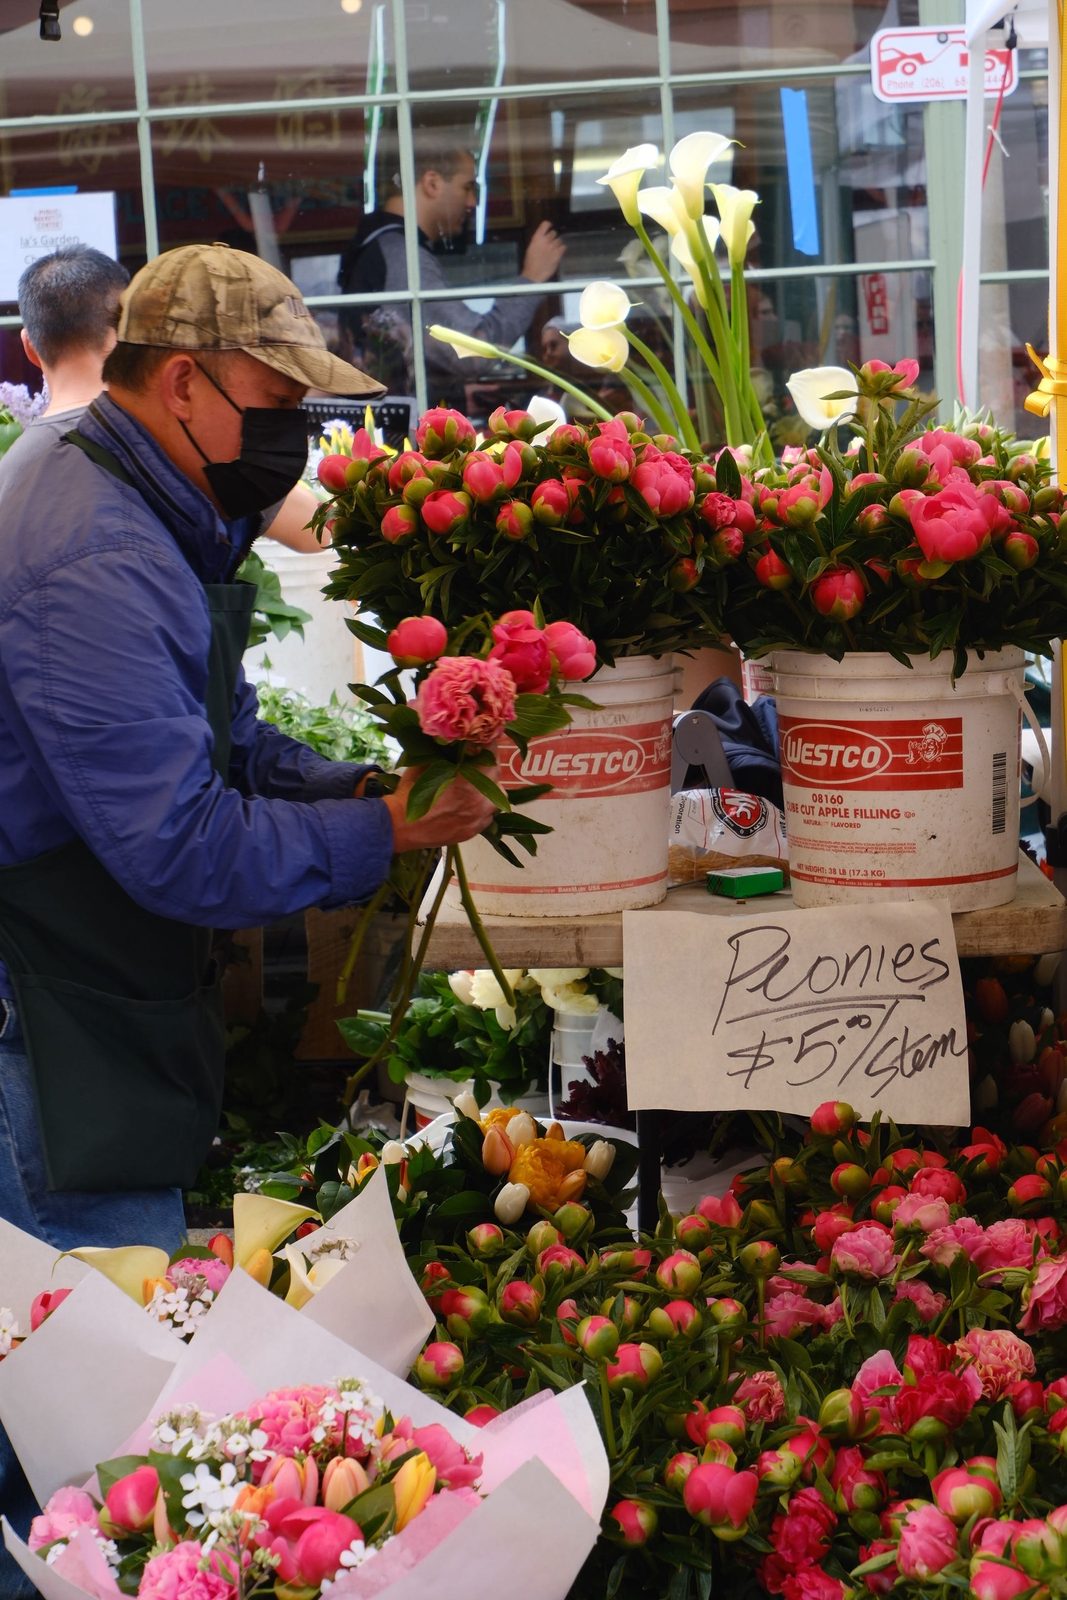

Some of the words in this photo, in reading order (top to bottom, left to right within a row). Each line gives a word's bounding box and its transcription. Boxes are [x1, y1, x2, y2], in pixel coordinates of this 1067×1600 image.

[520, 749, 639, 777] WESTCO
[786, 736, 881, 769] WESTCO
[811, 793, 844, 805] 08160
[801, 803, 815, 816] CUT
[818, 806, 850, 819] APPLE
[853, 808, 901, 820] FILLING
[828, 867, 837, 875] 38
[838, 868, 847, 876] LB
[848, 869, 869, 878] (17.3
[870, 870, 886, 878] KG)
[712, 925, 950, 1035] Peonies
